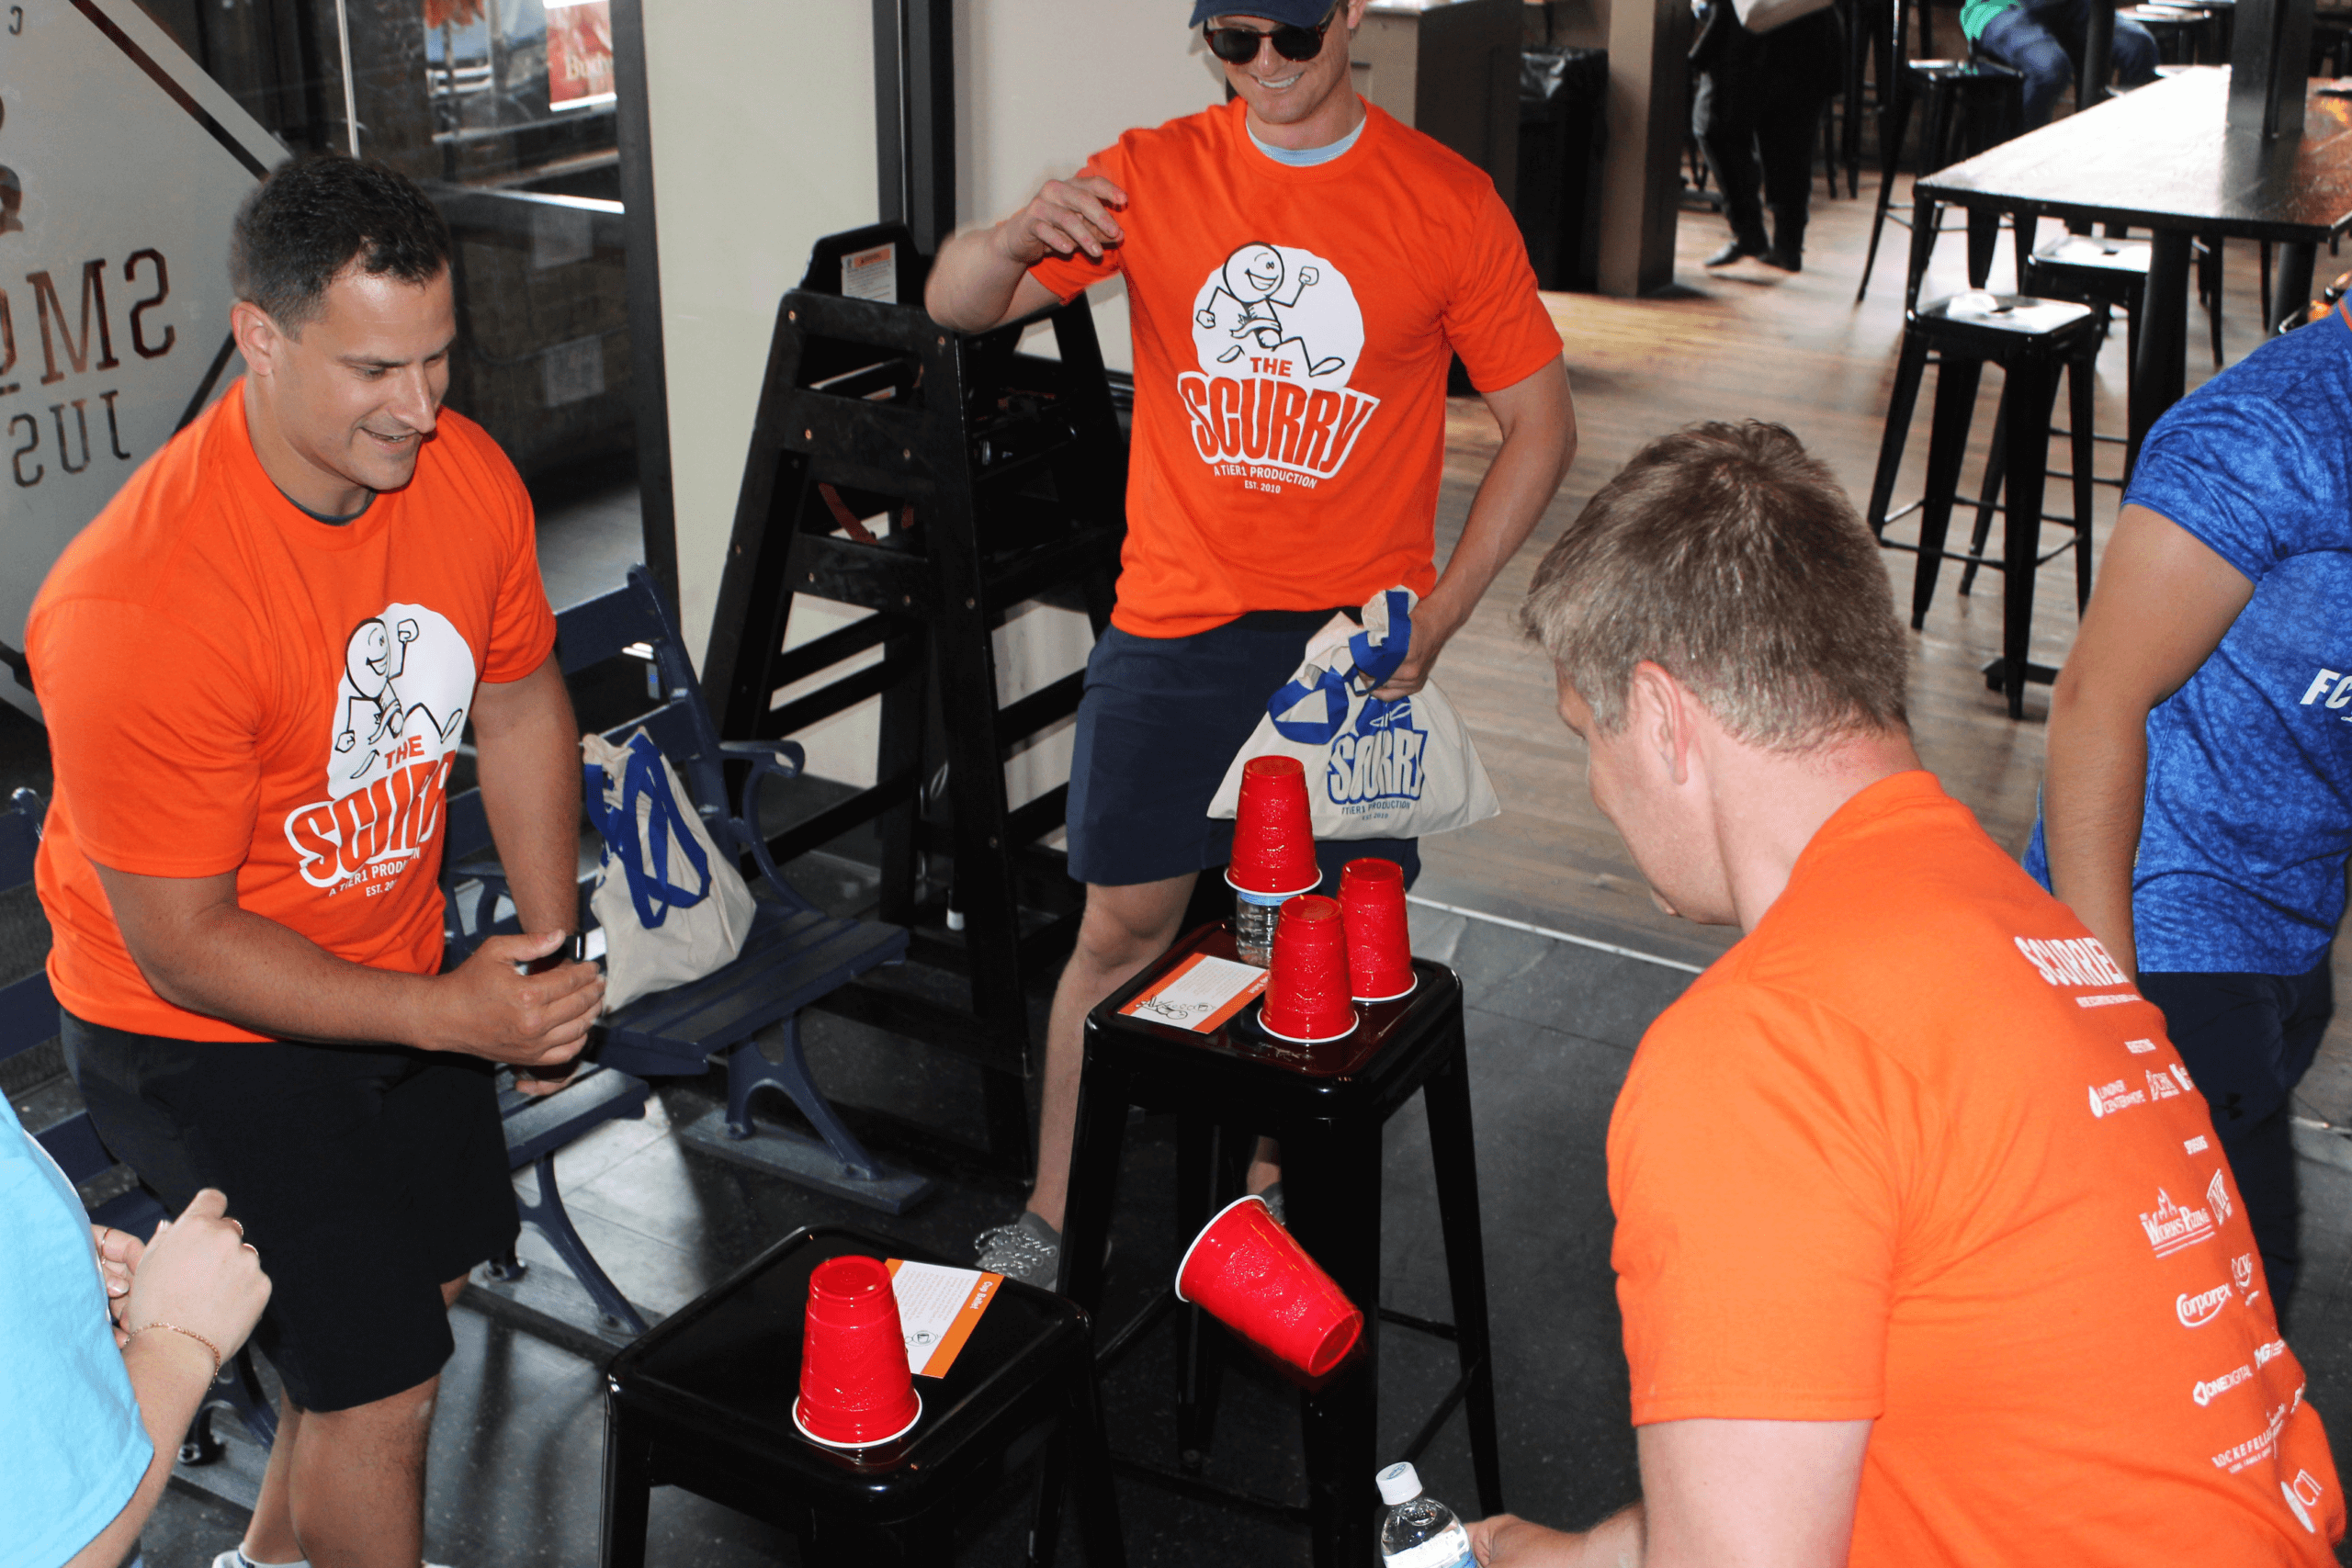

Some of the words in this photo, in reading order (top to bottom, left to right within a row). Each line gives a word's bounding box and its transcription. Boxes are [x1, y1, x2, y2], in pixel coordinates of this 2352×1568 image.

[1250, 356, 1293, 378] THE
[1178, 371, 1380, 478] SCURRY
[1214, 465, 1221, 477] A
[1250, 466, 1317, 490] PRODUCTION
[1244, 479, 1259, 490] EST.
[1261, 482, 1281, 494] 2010
[384, 735, 424, 770] THE
[1368, 800, 1410, 811] PRODUCTION
[2176, 1282, 2233, 1327] Corporex
